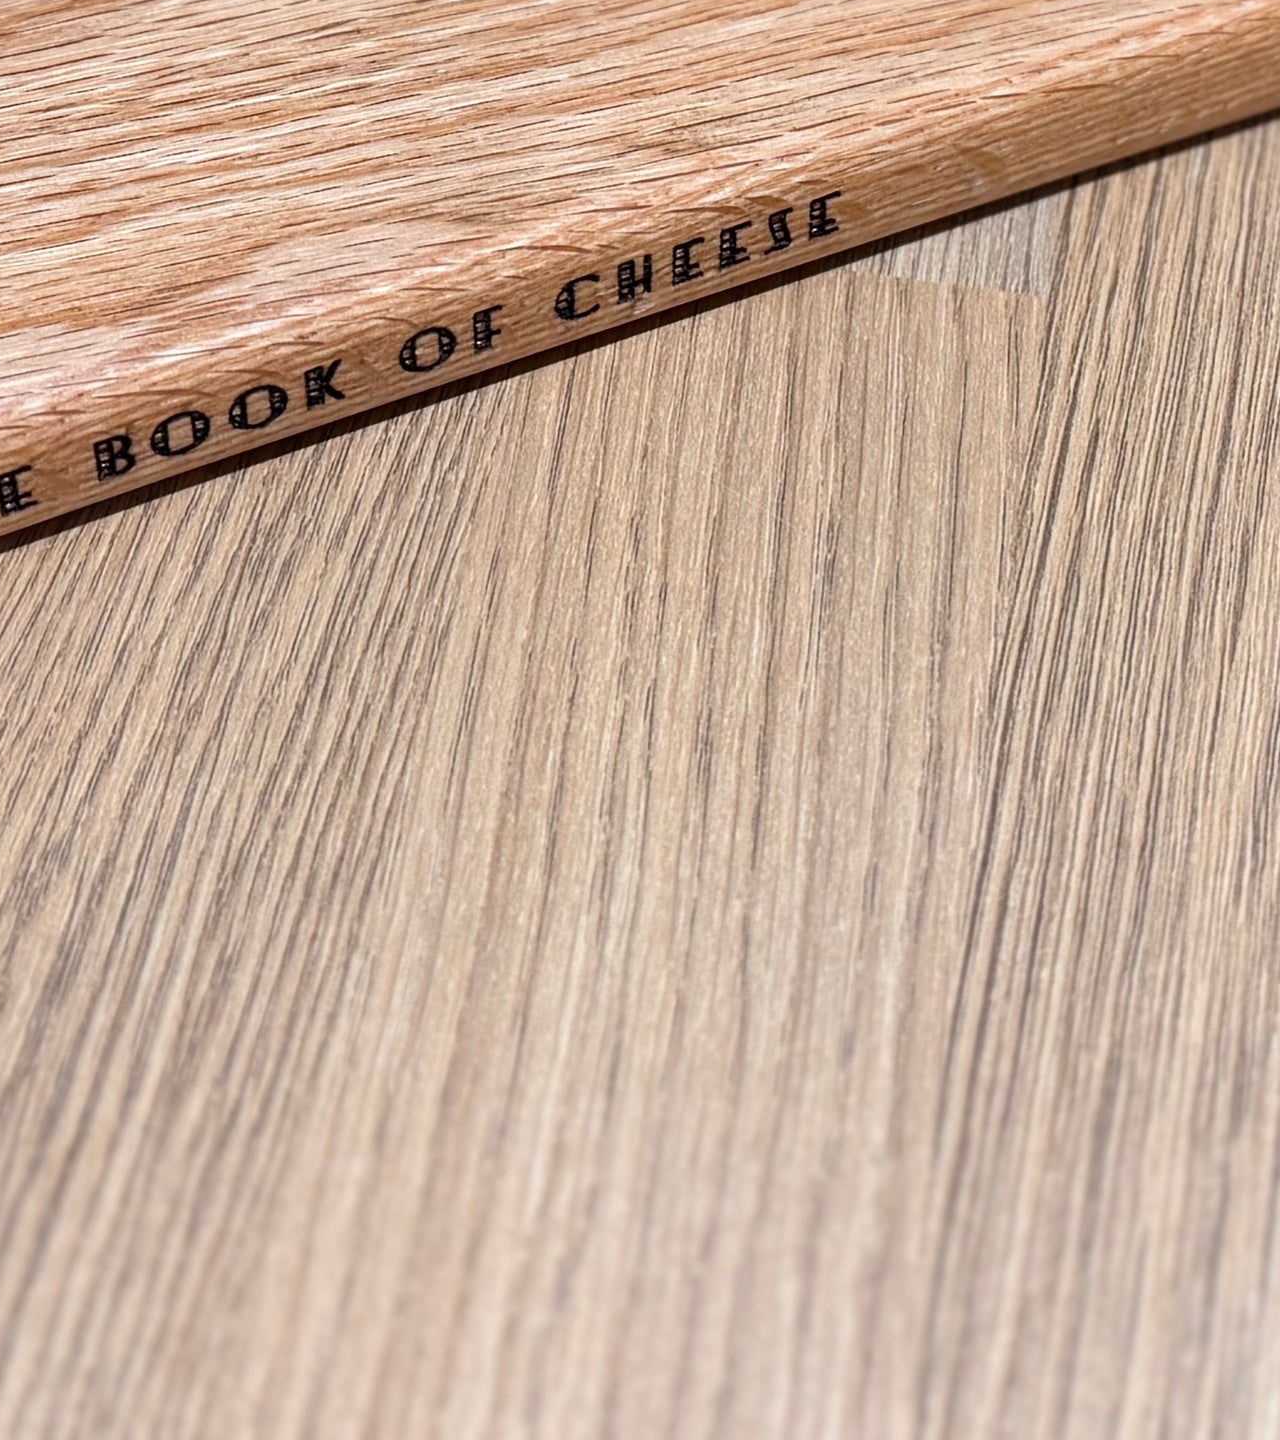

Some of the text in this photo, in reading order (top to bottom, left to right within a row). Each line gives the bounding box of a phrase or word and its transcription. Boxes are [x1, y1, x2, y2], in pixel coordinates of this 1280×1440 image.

[92, 357, 346, 482] BOOK
[397, 304, 506, 373] OF
[553, 190, 841, 321] CHEESE
